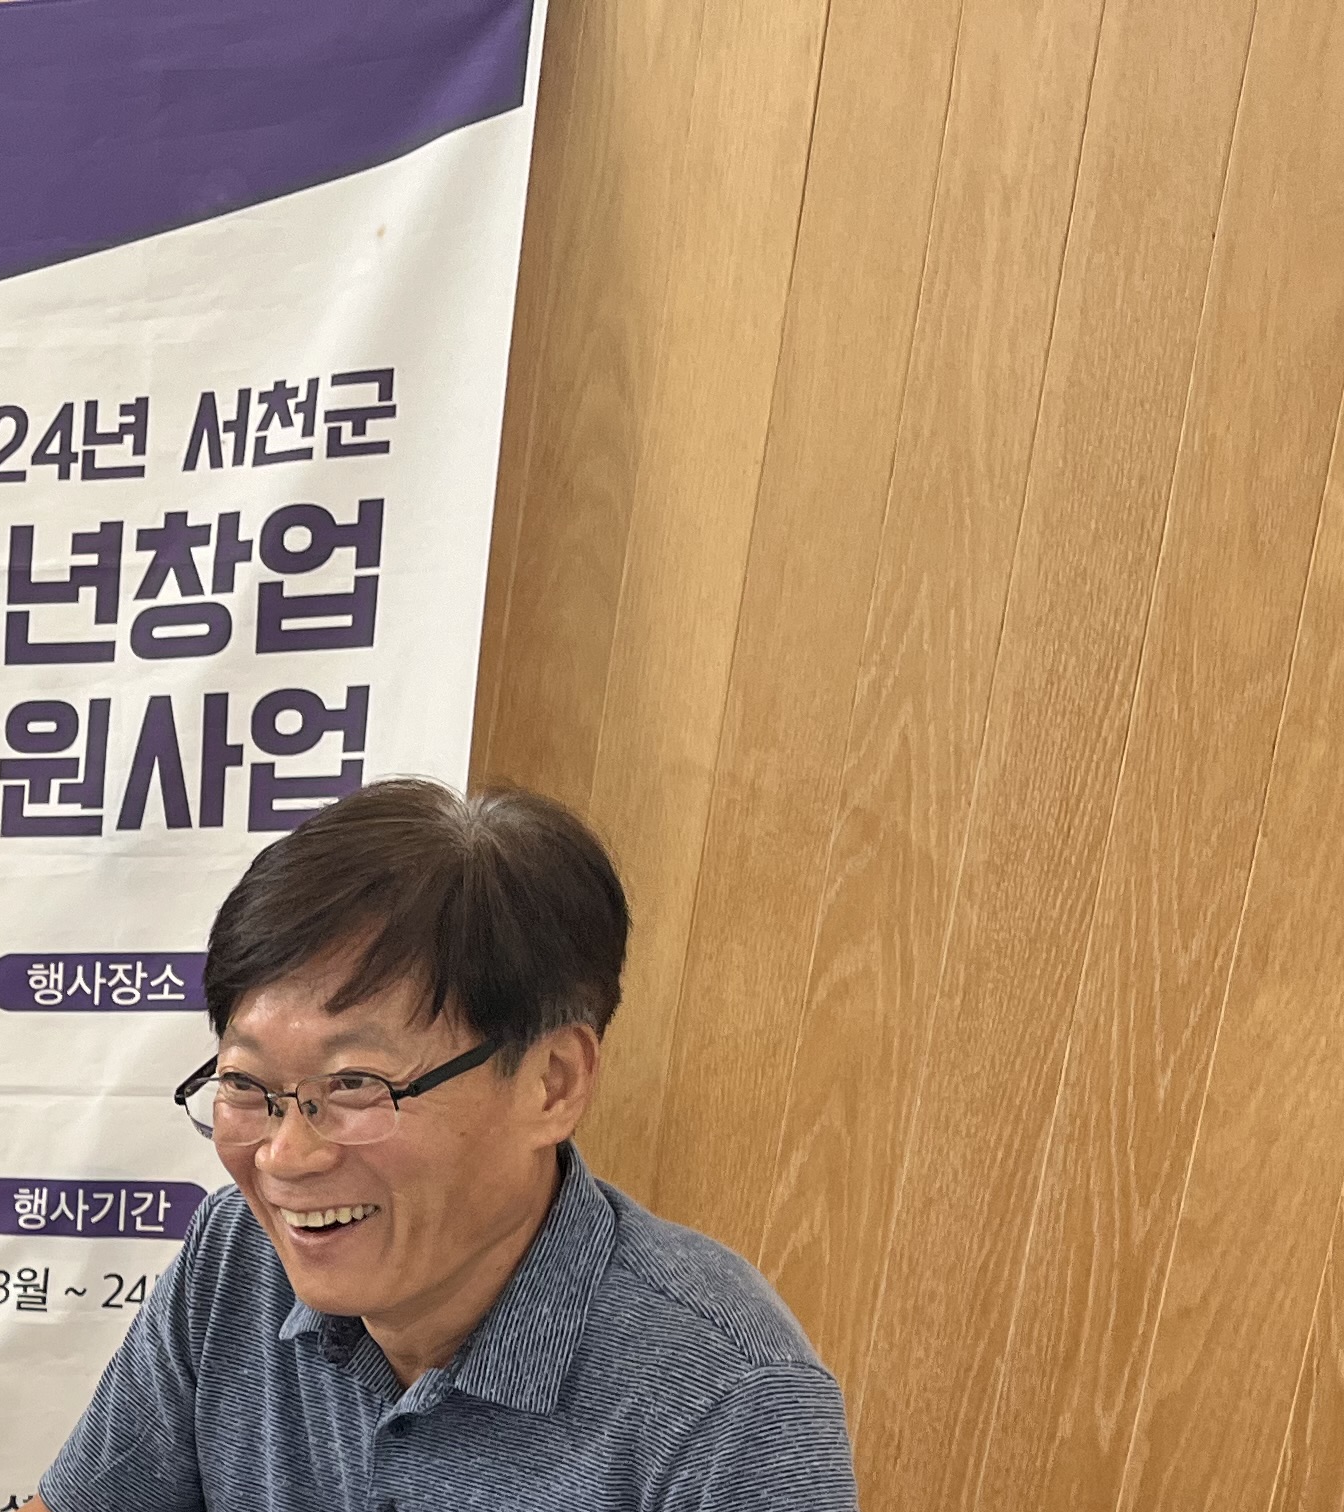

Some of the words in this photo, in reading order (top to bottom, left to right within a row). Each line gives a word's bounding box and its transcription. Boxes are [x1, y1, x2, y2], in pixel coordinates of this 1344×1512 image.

[182, 367, 398, 472] 서천군
[27, 961, 186, 1006] 행사장소
[13, 1187, 171, 1232] 행사기간
[101, 1273, 160, 1309] 24
